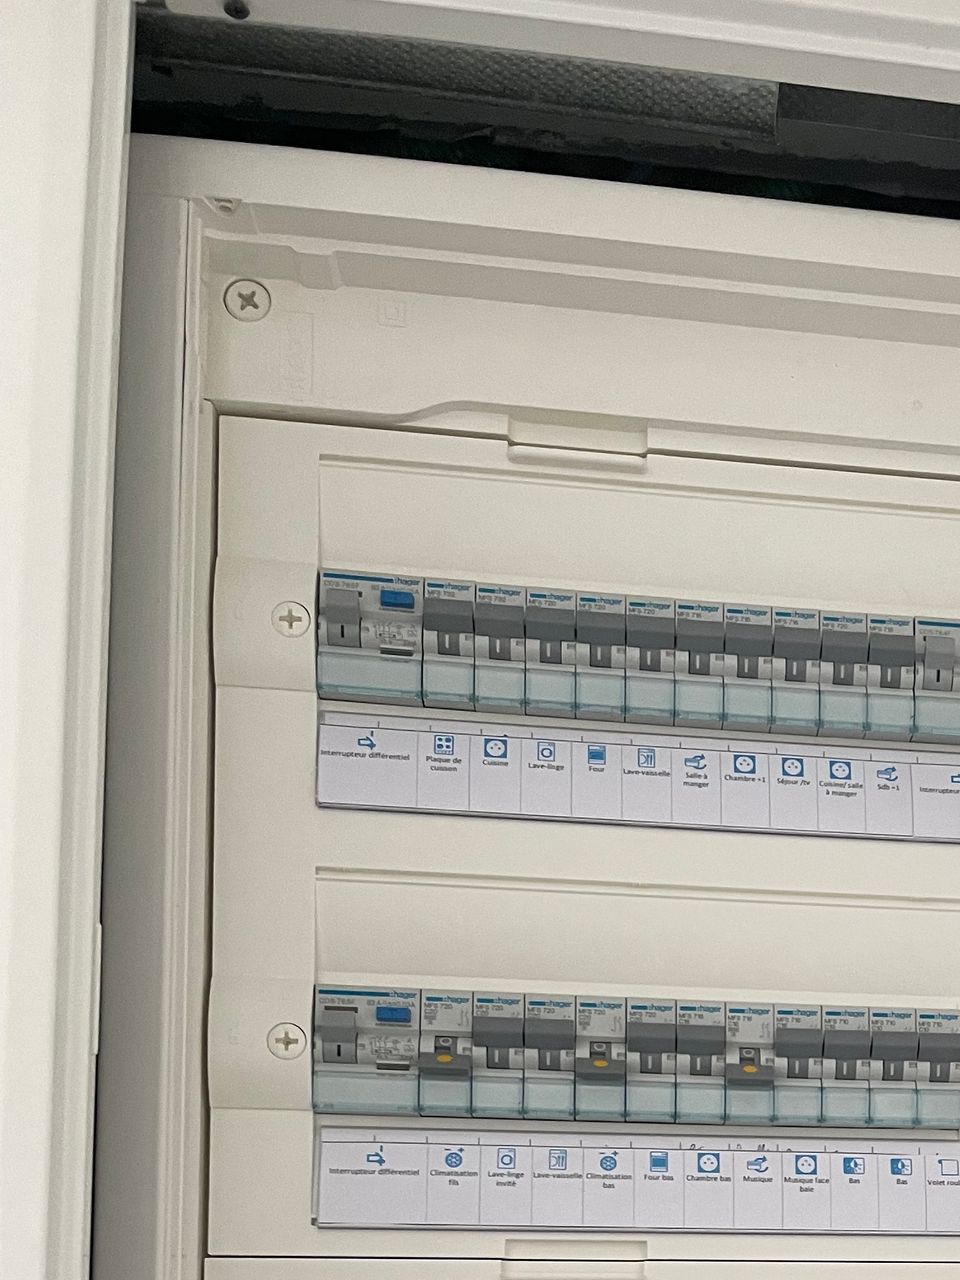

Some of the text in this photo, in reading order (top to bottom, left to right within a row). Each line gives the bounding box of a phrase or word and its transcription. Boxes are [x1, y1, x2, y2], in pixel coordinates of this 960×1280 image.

[320, 749, 410, 760] Interrupteur différentiel
[426, 755, 451, 764] Plaque
[482, 759, 509, 767] Cuisine
[528, 762, 565, 771] Lave-linge
[623, 768, 671, 777] Lave-vaisselle
[685, 771, 701, 780] Salle
[724, 775, 756, 783] Chambre
[777, 777, 798, 786] Séjour
[683, 780, 709, 789] manger
[848, 781, 863, 789] salle
[831, 790, 857, 798] manger
[919, 786, 960, 796] Interrupteur
[329, 1167, 420, 1176] Interrupteur différentiel
[430, 1169, 478, 1177] Climatisation
[488, 1171, 524, 1179] Lave-linge
[586, 1172, 632, 1180] Climatisation
[686, 1174, 718, 1182] Chambre
[743, 1175, 773, 1184] Musique
[784, 1176, 813, 1184] Musique
